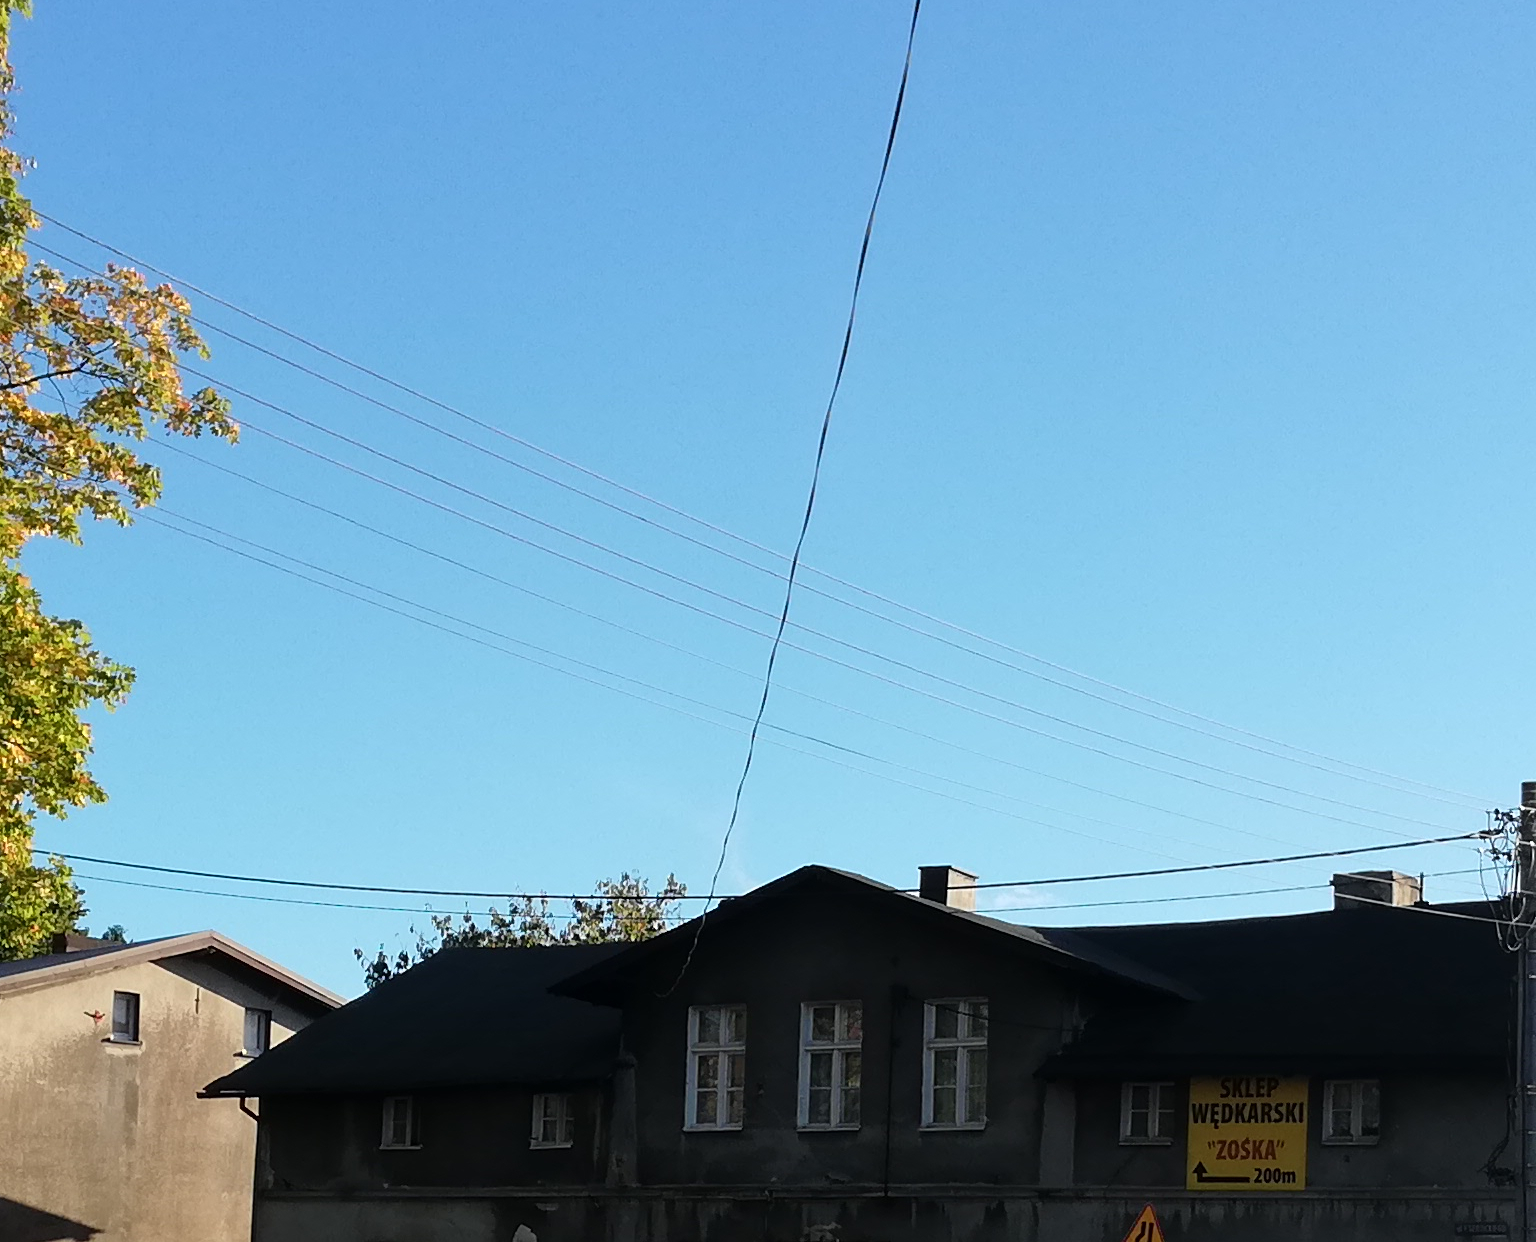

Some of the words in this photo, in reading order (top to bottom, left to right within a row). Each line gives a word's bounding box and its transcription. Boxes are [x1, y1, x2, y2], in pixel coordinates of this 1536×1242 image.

[1219, 1077, 1280, 1099] SKLEP
[1191, 1101, 1305, 1130] WĘDKARSKI
[1253, 1166, 1297, 1184] 200m
